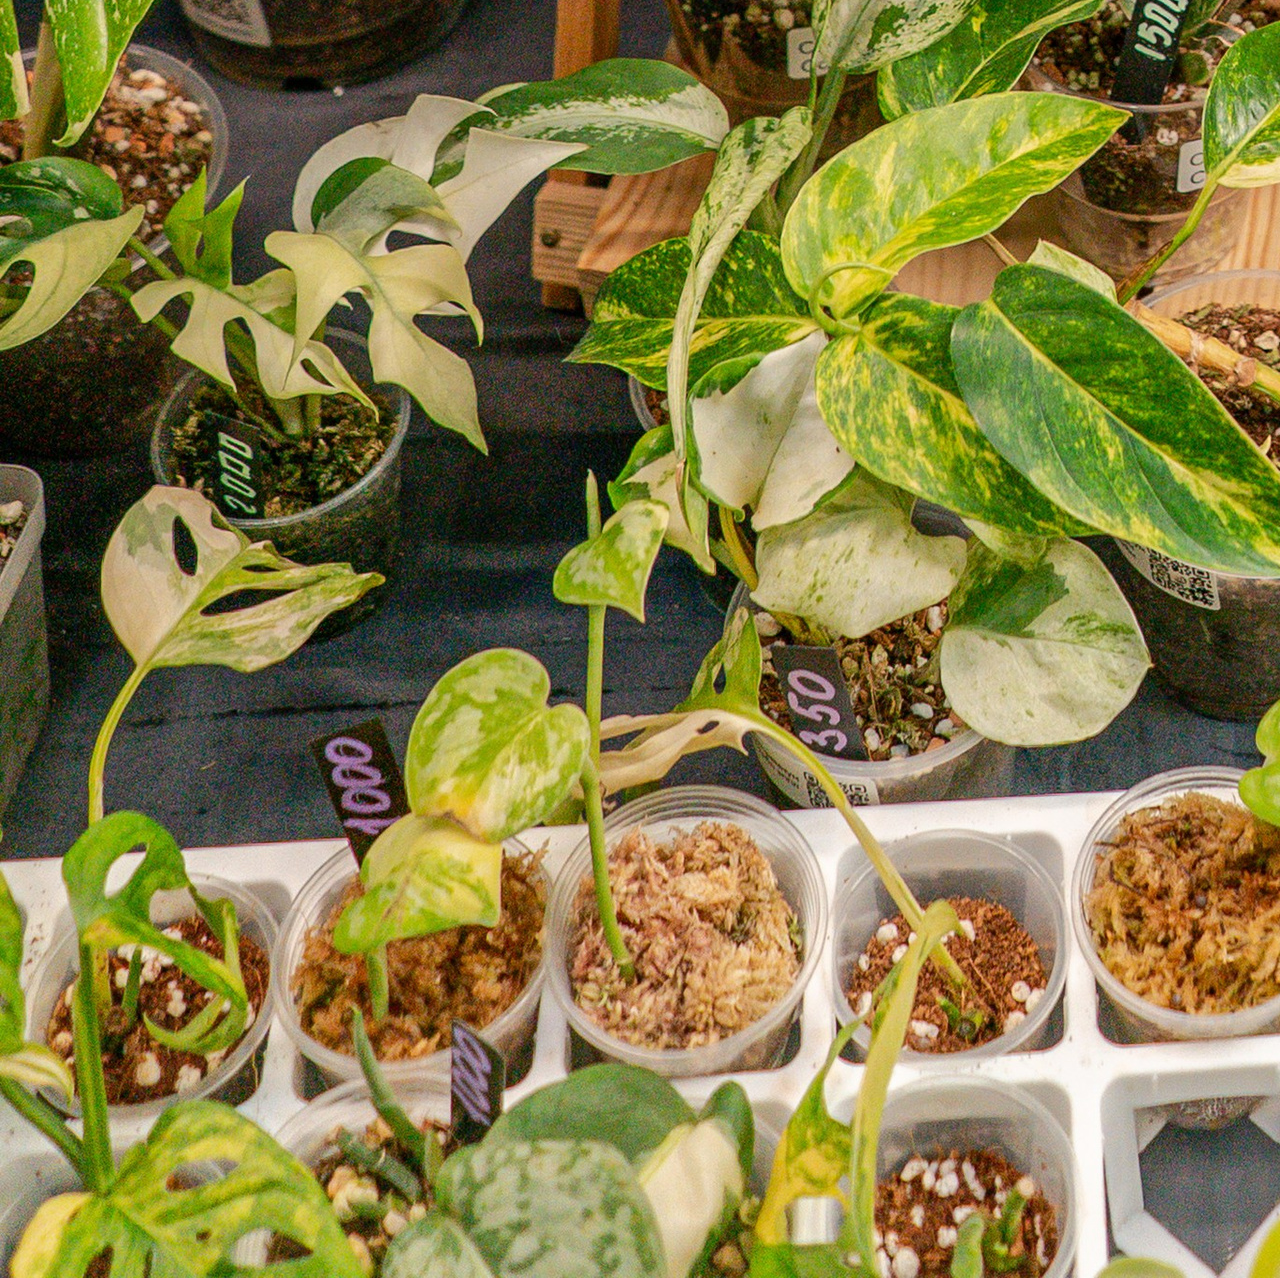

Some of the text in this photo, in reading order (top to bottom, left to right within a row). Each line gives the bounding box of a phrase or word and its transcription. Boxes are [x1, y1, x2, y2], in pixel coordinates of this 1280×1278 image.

[218, 432, 255, 514] 2000
[788, 669, 846, 752] 350
[325, 735, 398, 836] 1000
